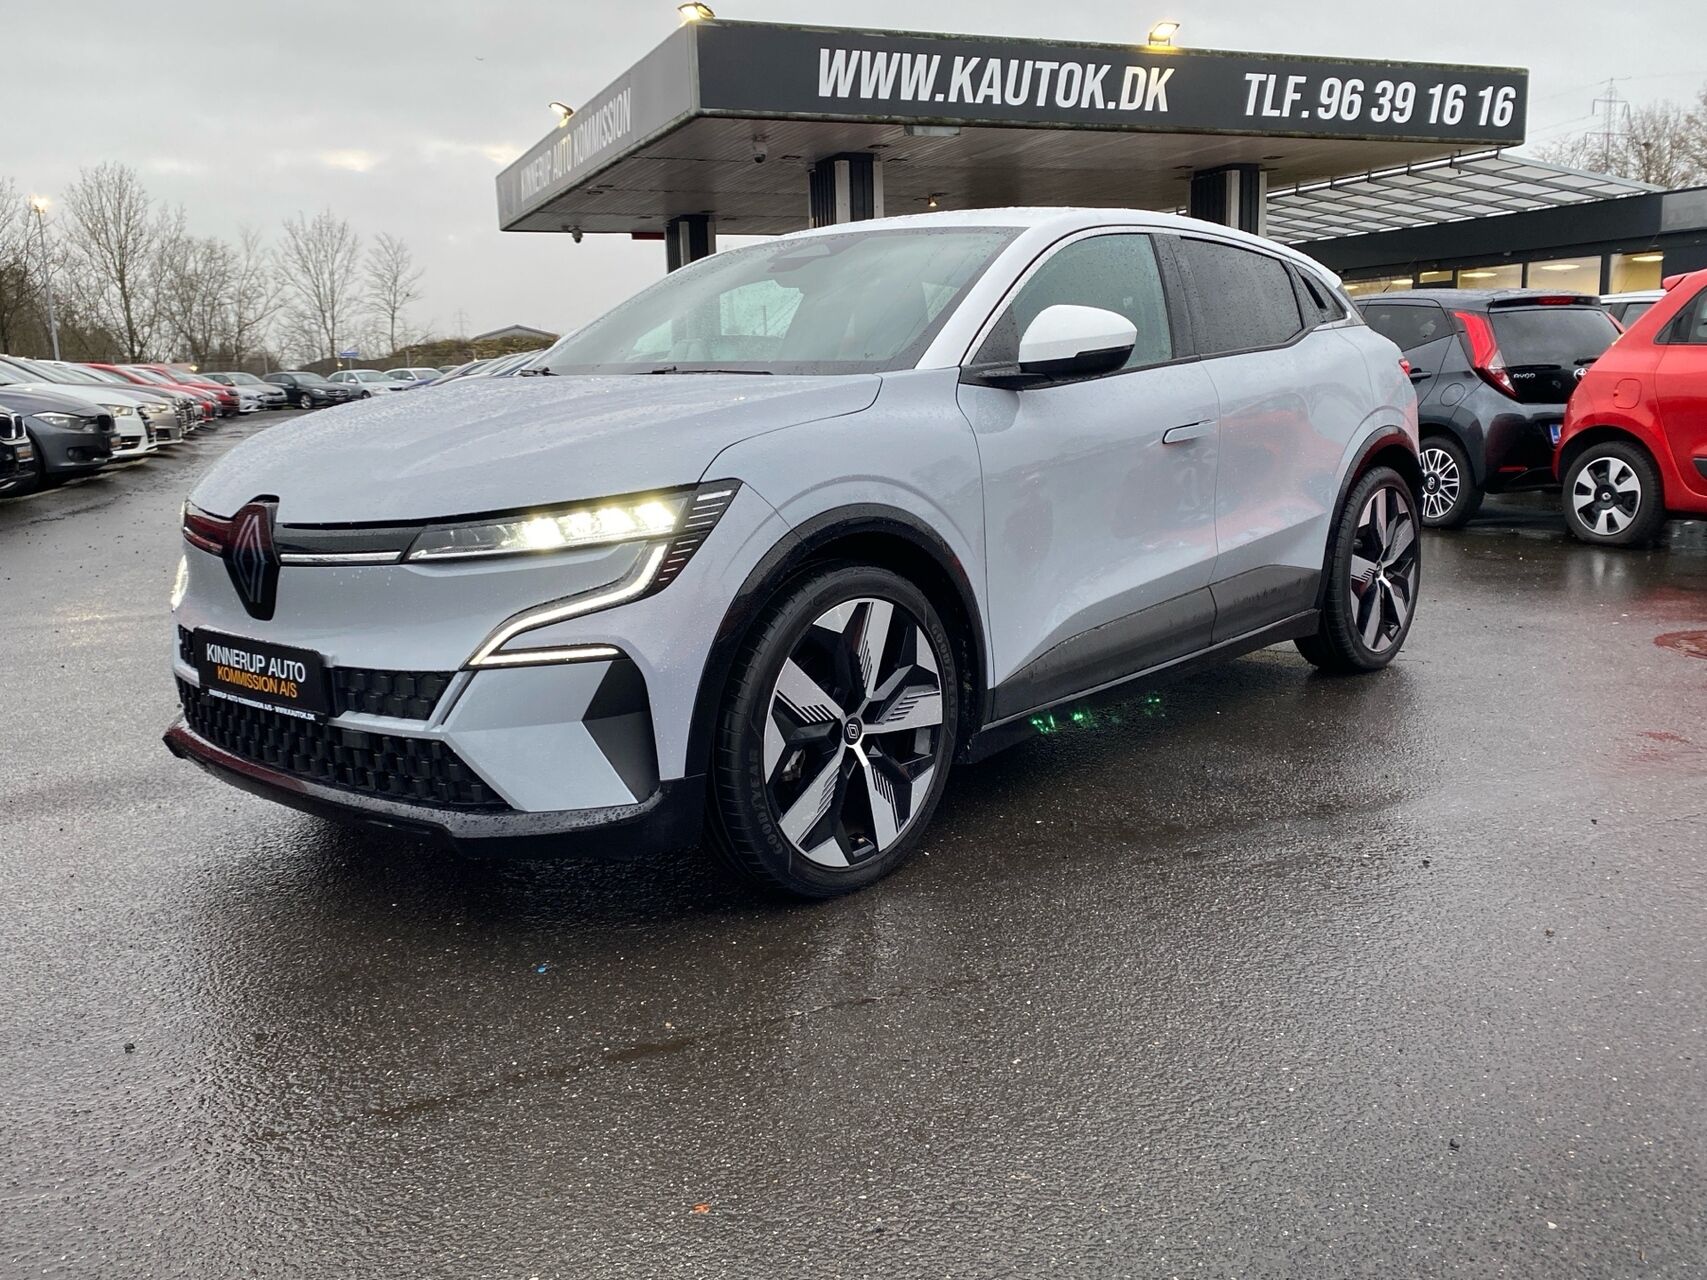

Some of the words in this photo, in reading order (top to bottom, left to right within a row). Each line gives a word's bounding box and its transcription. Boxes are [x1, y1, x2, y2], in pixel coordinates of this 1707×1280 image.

[818, 47, 1175, 113] WWW.KAUTOK.DK
[1243, 72, 1311, 119] TLF.
[1318, 77, 1365, 122] 96
[1370, 79, 1417, 125] 39
[1428, 83, 1467, 127] 16
[1477, 85, 1518, 128] 16
[573, 87, 631, 169] KOMMISSION
[206, 643, 265, 674] KINNERUP
[268, 657, 306, 683] AUTO
[217, 665, 278, 694] KOMMISSION
[279, 681, 298, 698] A/S
